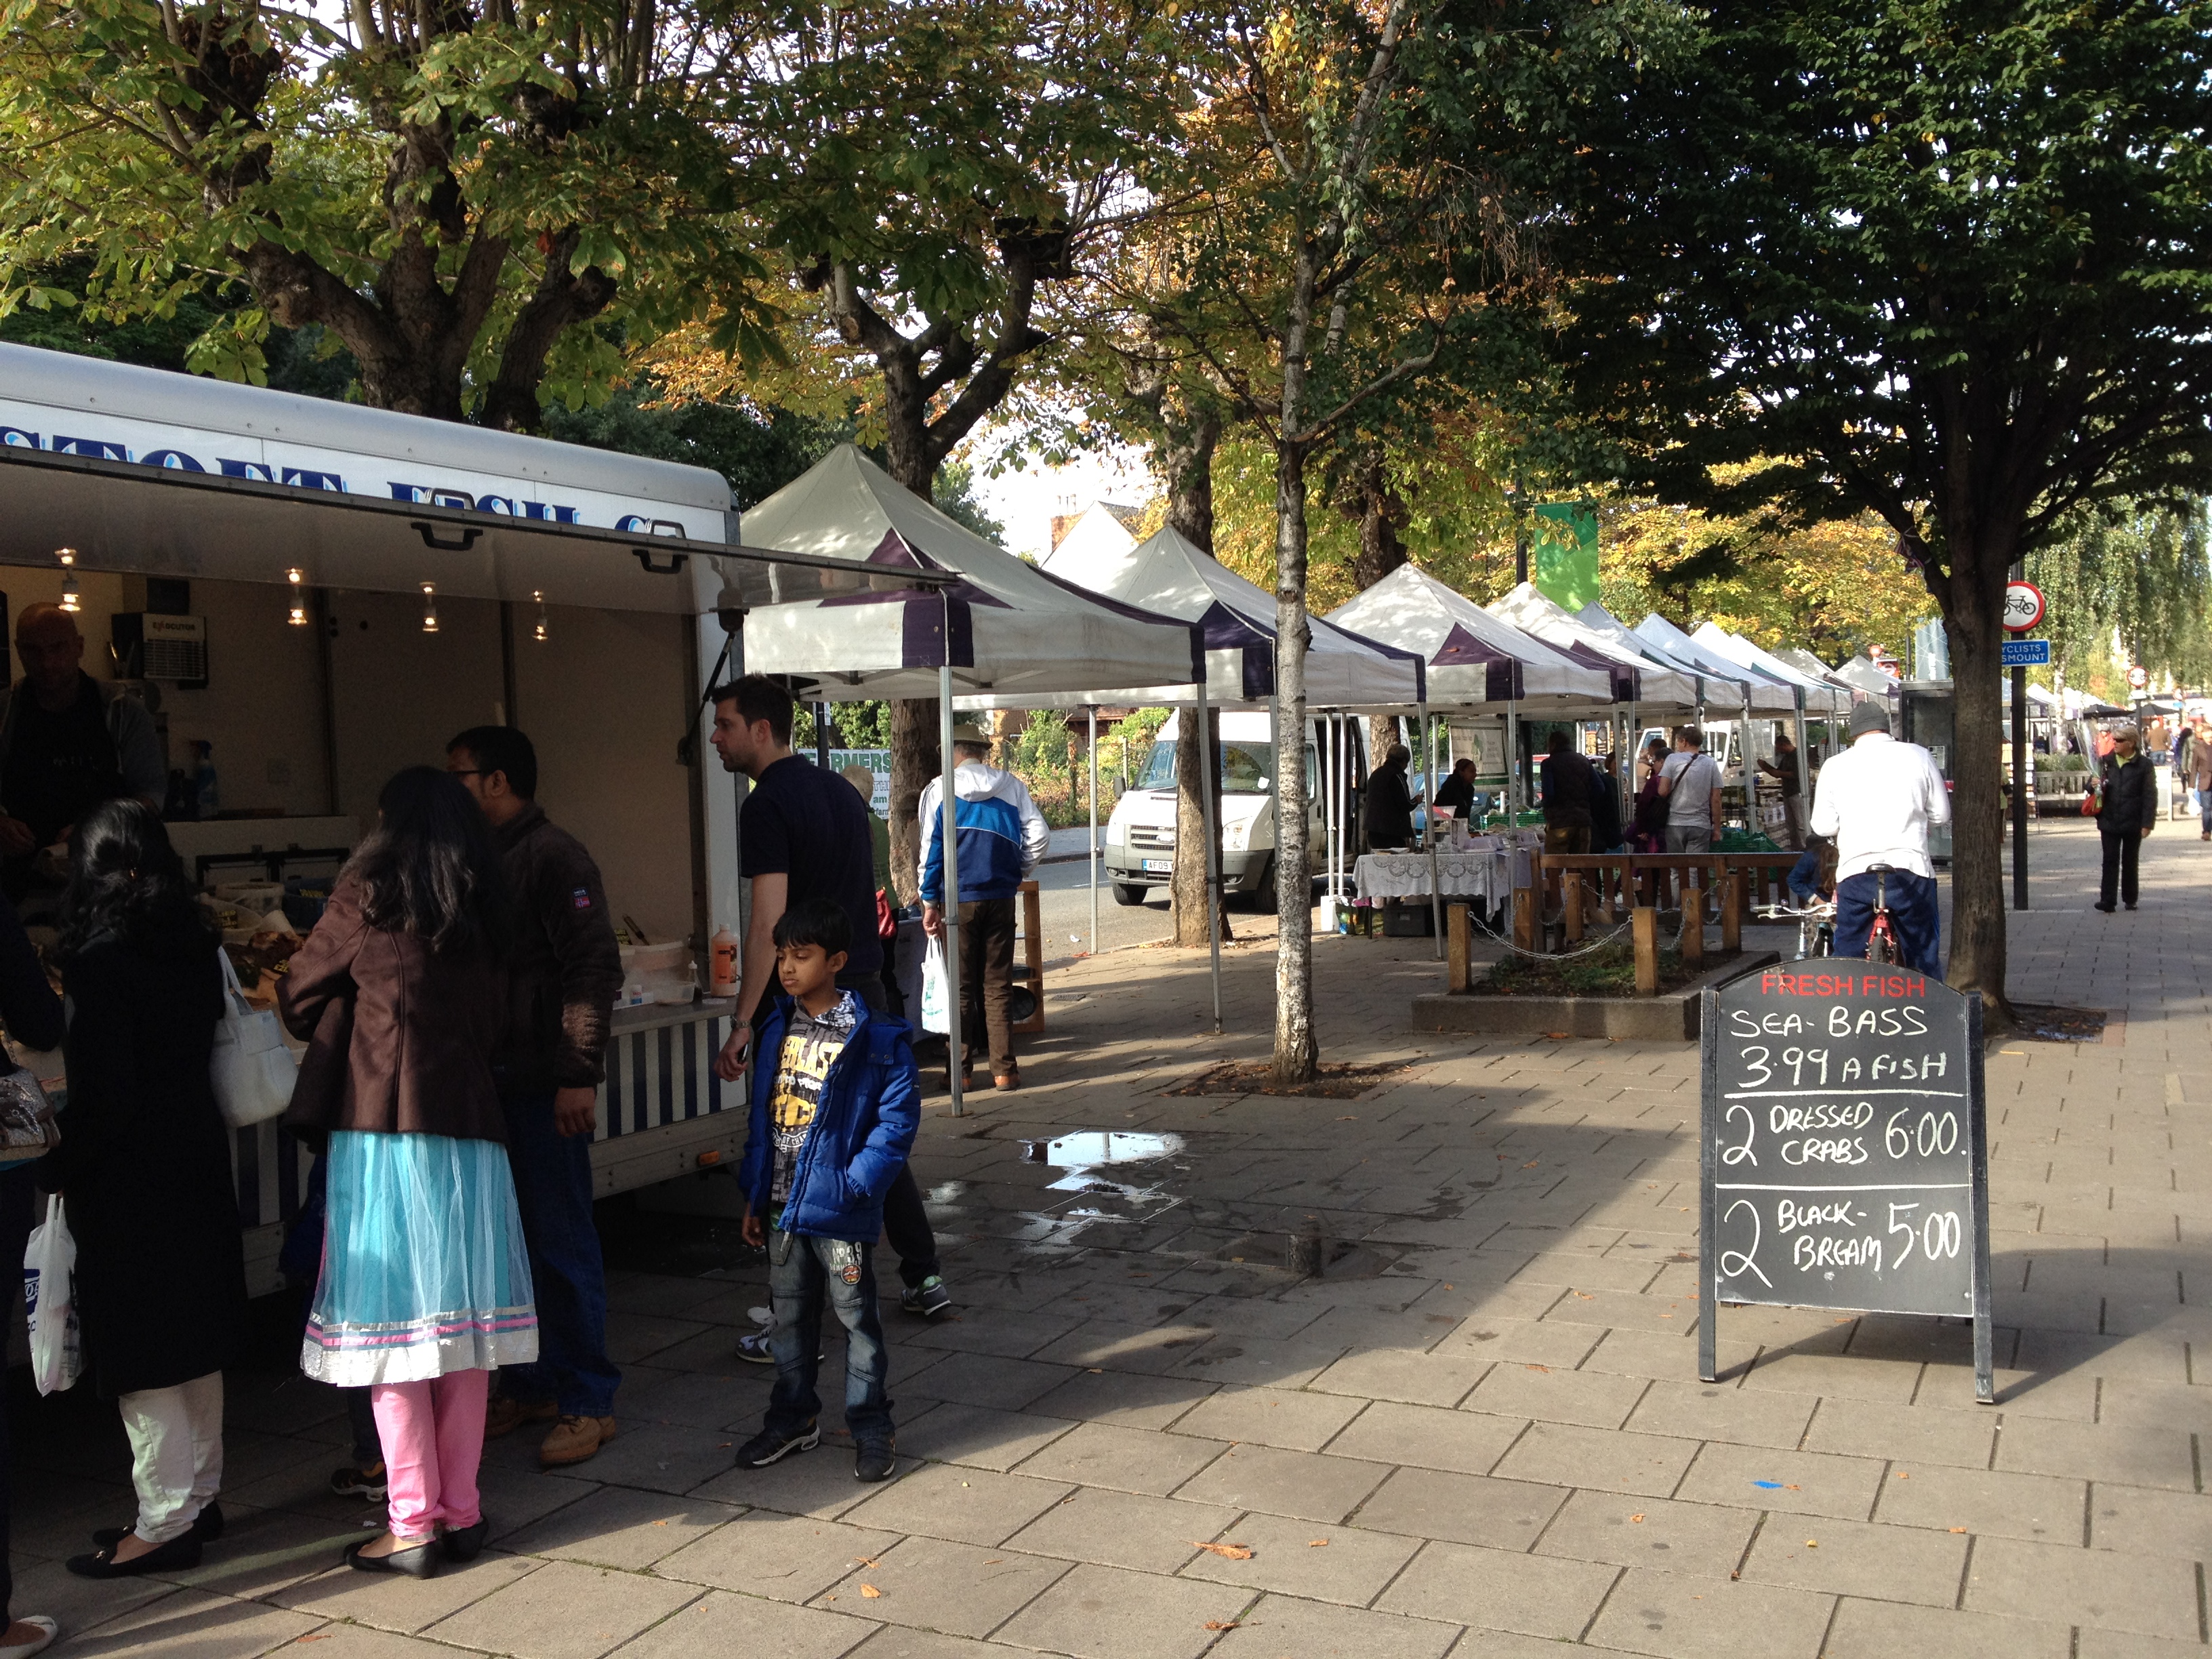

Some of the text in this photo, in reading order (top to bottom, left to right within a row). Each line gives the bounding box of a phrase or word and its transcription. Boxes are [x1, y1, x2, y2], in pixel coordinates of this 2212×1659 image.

[2002, 644, 2041, 653] YCLISTS
[2002, 653, 2045, 662] SMOUNT
[804, 752, 891, 774] FRMERS
[1762, 975, 1926, 998] FRESH FISH
[1828, 1005, 1928, 1037] BASS
[1738, 1045, 1829, 1088] 3.99
[1842, 1056, 1862, 1083] A
[1722, 1105, 1758, 1167] 2
[1769, 1102, 1874, 1134] DRESSED
[1780, 1136, 1869, 1166] CRABS
[1721, 1199, 1773, 1288] 2
[1889, 1203, 1961, 1271] 5.00
[1793, 1234, 1882, 1272] BREAM
